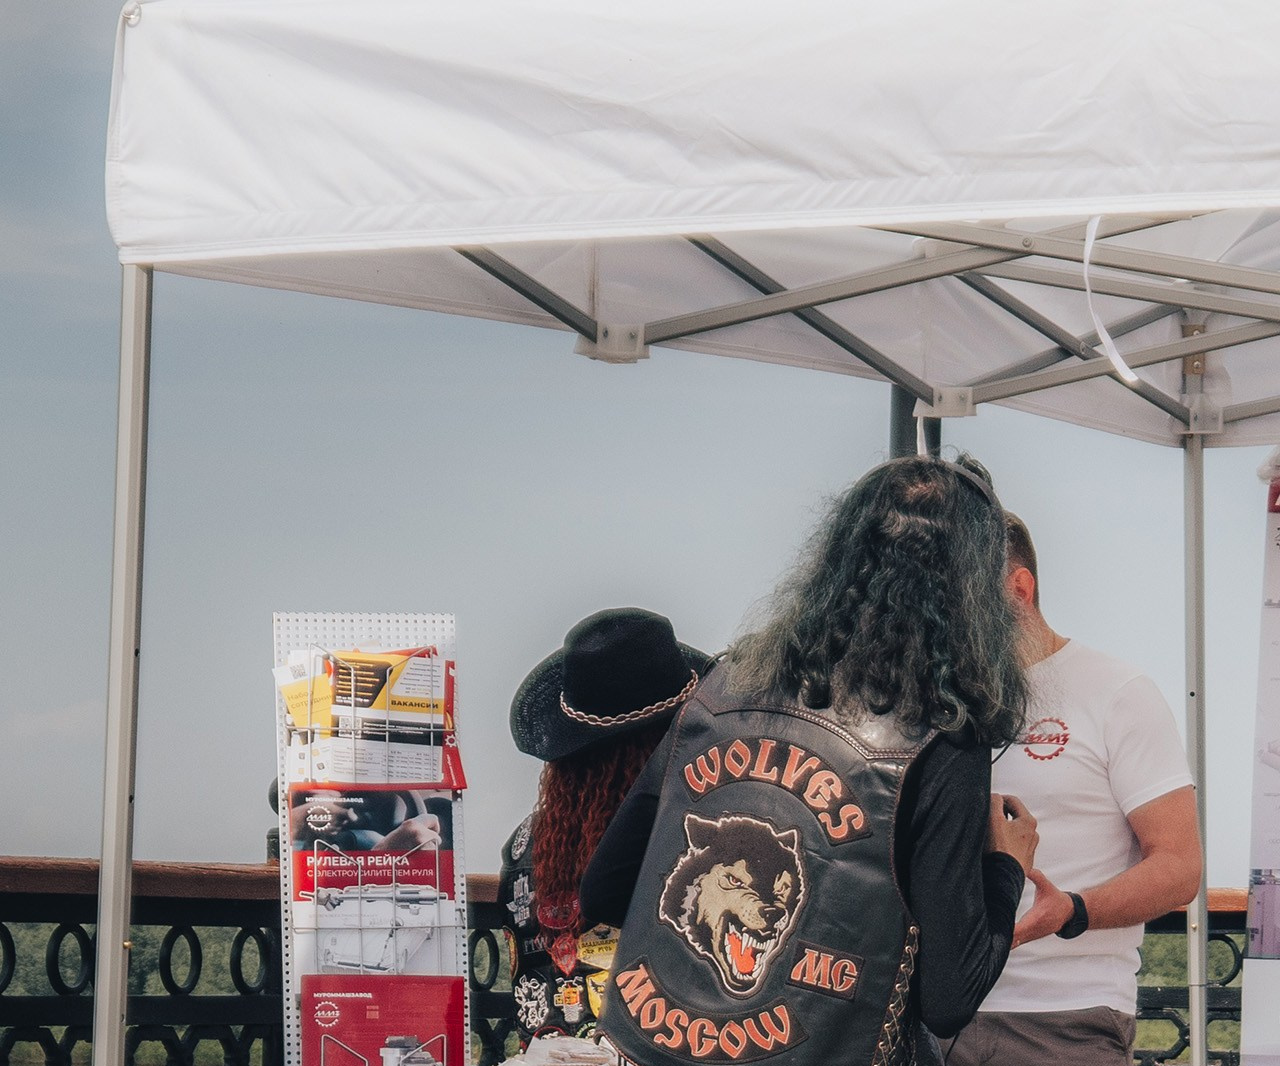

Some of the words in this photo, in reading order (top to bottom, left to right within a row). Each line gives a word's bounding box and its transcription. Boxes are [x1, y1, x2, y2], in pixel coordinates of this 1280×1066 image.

[391, 699, 439, 709] ВАКАНСИИ
[684, 739, 865, 839] WOLVES
[307, 856, 364, 867] РУЛЕВАЯ
[367, 854, 409, 866] РЕЙКА
[615, 964, 791, 1058] MOSCOW
